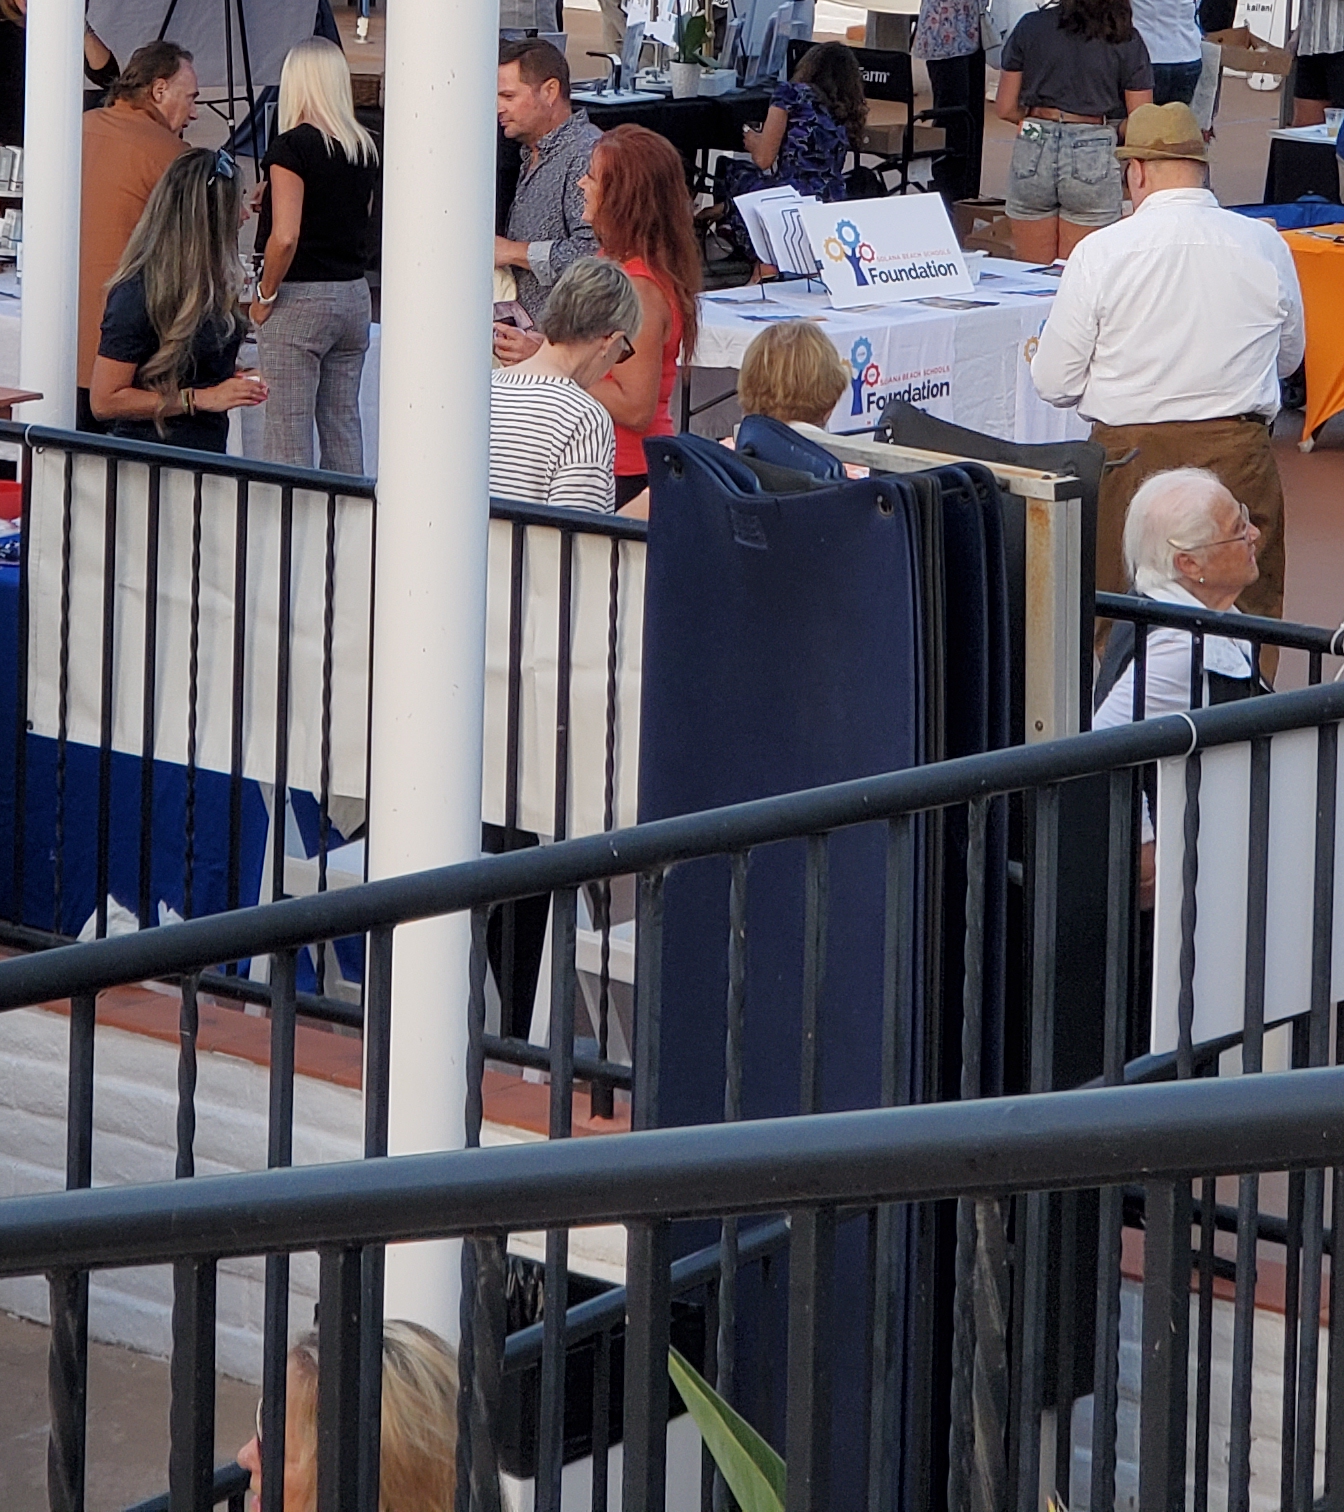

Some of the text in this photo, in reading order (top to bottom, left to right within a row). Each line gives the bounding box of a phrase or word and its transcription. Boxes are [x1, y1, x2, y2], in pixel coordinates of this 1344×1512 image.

[859, 67, 887, 83] arm
[902, 251, 921, 260] BEACH
[868, 260, 958, 285] Foundation
[902, 371, 921, 381] BEACH
[923, 365, 950, 376] SCHOOLS
